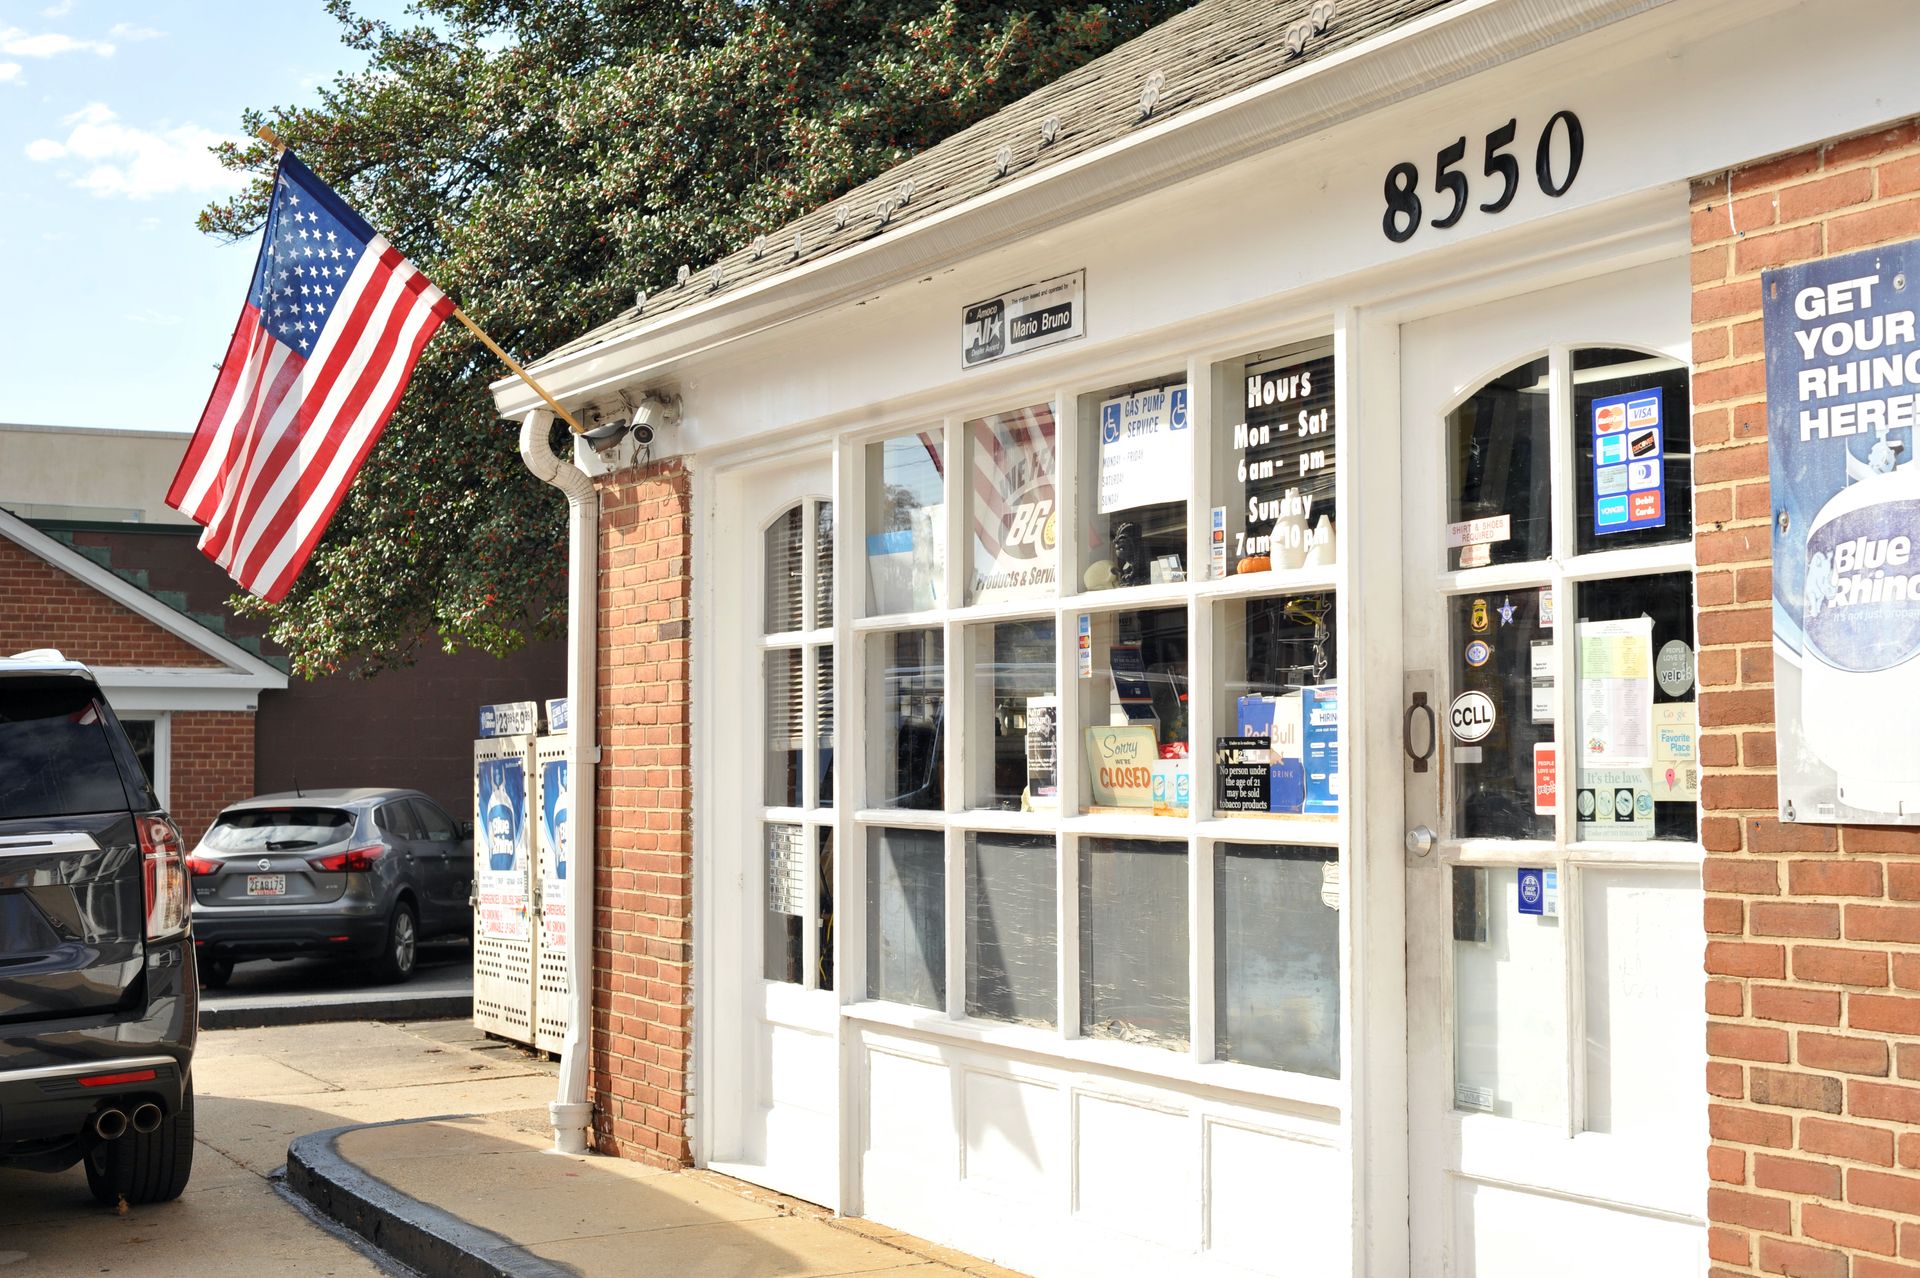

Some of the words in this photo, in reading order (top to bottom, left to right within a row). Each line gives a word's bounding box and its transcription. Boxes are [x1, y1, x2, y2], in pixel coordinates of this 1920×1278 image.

[1383, 110, 1584, 244] 8550
[1795, 275, 1880, 321] GET
[976, 305, 998, 320] Amoco
[1012, 317, 1038, 340] Mario
[1042, 309, 1070, 331] Bruno
[1794, 310, 1916, 361] YOUR
[1247, 371, 1312, 409] Hours
[1124, 399, 1140, 418] GAS
[1142, 394, 1166, 414] PUMP
[1633, 407, 1652, 420] VISA
[1127, 416, 1160, 439] SERVICE
[1233, 423, 1270, 451] Mon
[1278, 423, 1289, 432] -
[1298, 408, 1328, 438] Sat
[1299, 450, 1325, 477] pm
[1248, 488, 1313, 523] Sunday
[1635, 496, 1655, 506] Debit
[1635, 506, 1655, 517] Cards
[1005, 499, 1053, 547] BG
[1452, 524, 1472, 535] SHIRT
[1482, 519, 1504, 530] SHOES
[1462, 529, 1494, 543] REQUIRED
[1834, 535, 1911, 575] Blue
[975, 571, 1019, 592] Products
[1019, 570, 1027, 587] &
[1661, 669, 1682, 684] yelp
[1452, 704, 1491, 728] CCLL
[1270, 723, 1295, 745] Bull
[1661, 733, 1691, 743] Favorite
[1103, 734, 1138, 759] Sorry
[1670, 743, 1691, 752] Place
[1100, 766, 1151, 789] CLOSED
[1219, 765, 1229, 775] No
[1229, 767, 1249, 777] person
[1249, 765, 1268, 775] under
[1225, 776, 1235, 786] the
[1235, 778, 1247, 788] age
[1246, 776, 1254, 786] of
[1272, 770, 1294, 779] DRINK
[1586, 772, 1603, 785] It's
[1604, 771, 1621, 784] the
[1622, 770, 1643, 784] law.
[1226, 789, 1239, 800] may
[1240, 787, 1248, 798] be
[1247, 787, 1260, 798] sold
[1219, 798, 1242, 809] tobacco
[1241, 798, 1268, 812] products
